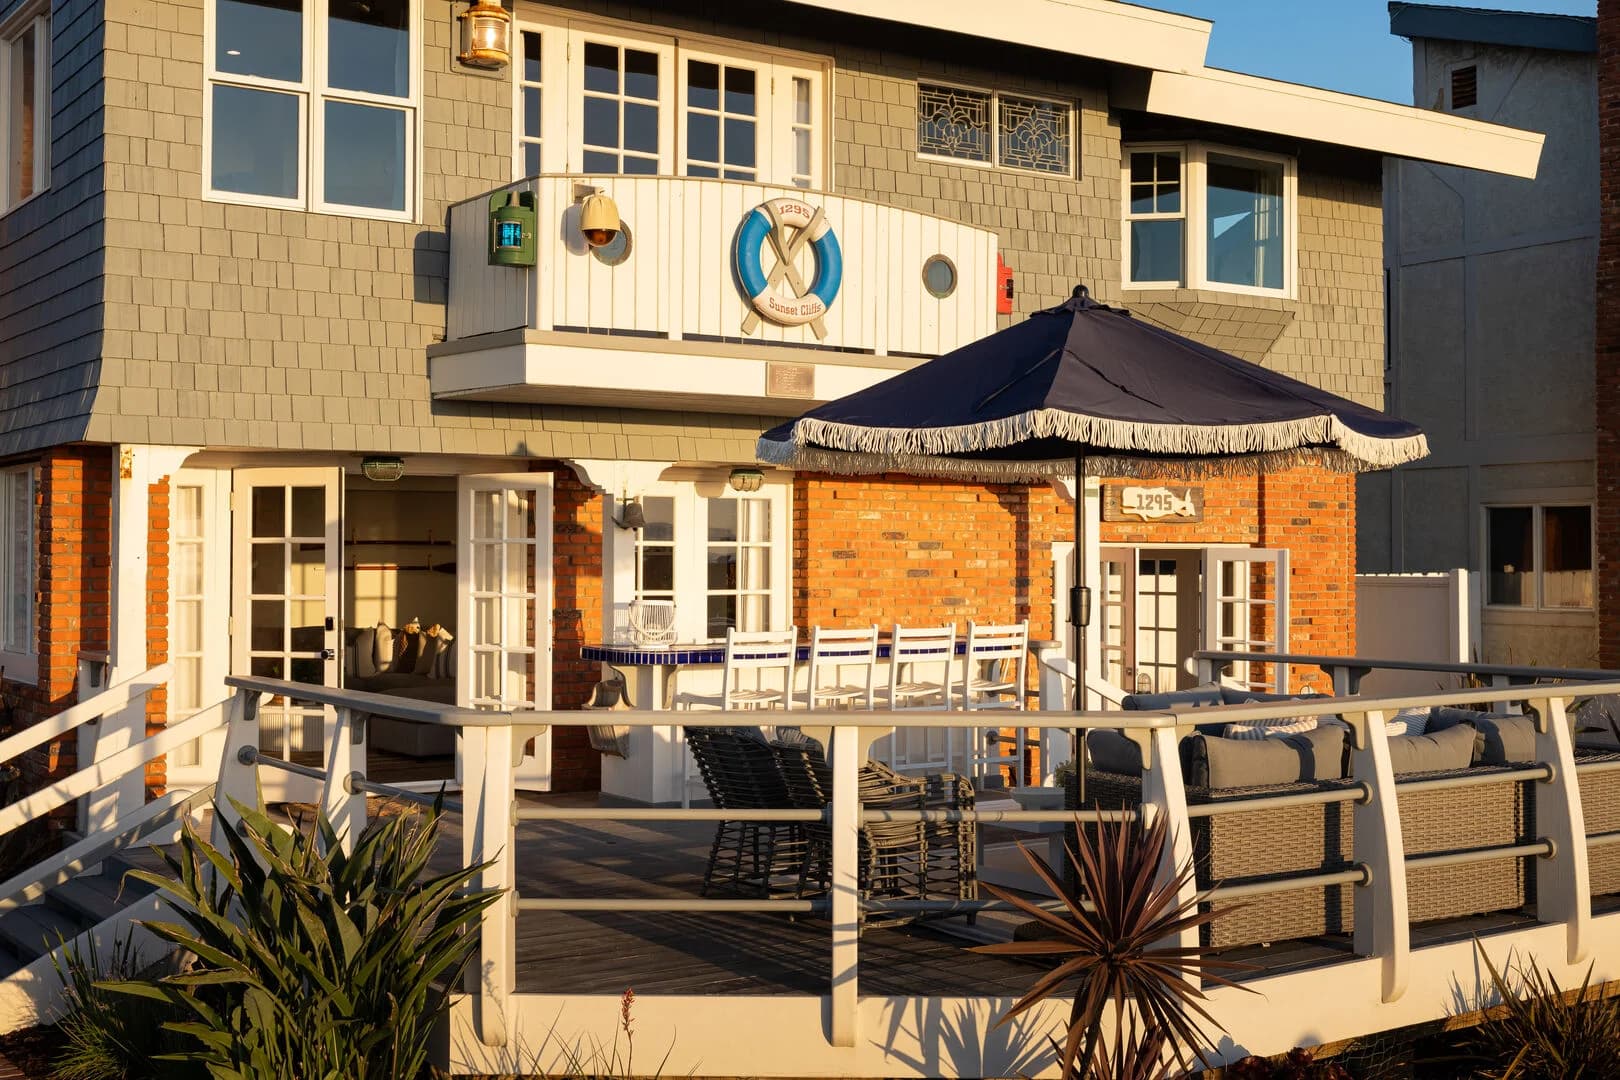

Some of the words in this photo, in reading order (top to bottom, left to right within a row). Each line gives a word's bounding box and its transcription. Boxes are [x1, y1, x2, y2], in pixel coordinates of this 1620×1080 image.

[779, 204, 810, 219] 1295
[769, 296, 798, 316] Sunset
[800, 303, 822, 316] Cliffs
[1136, 494, 1172, 511] 1295
